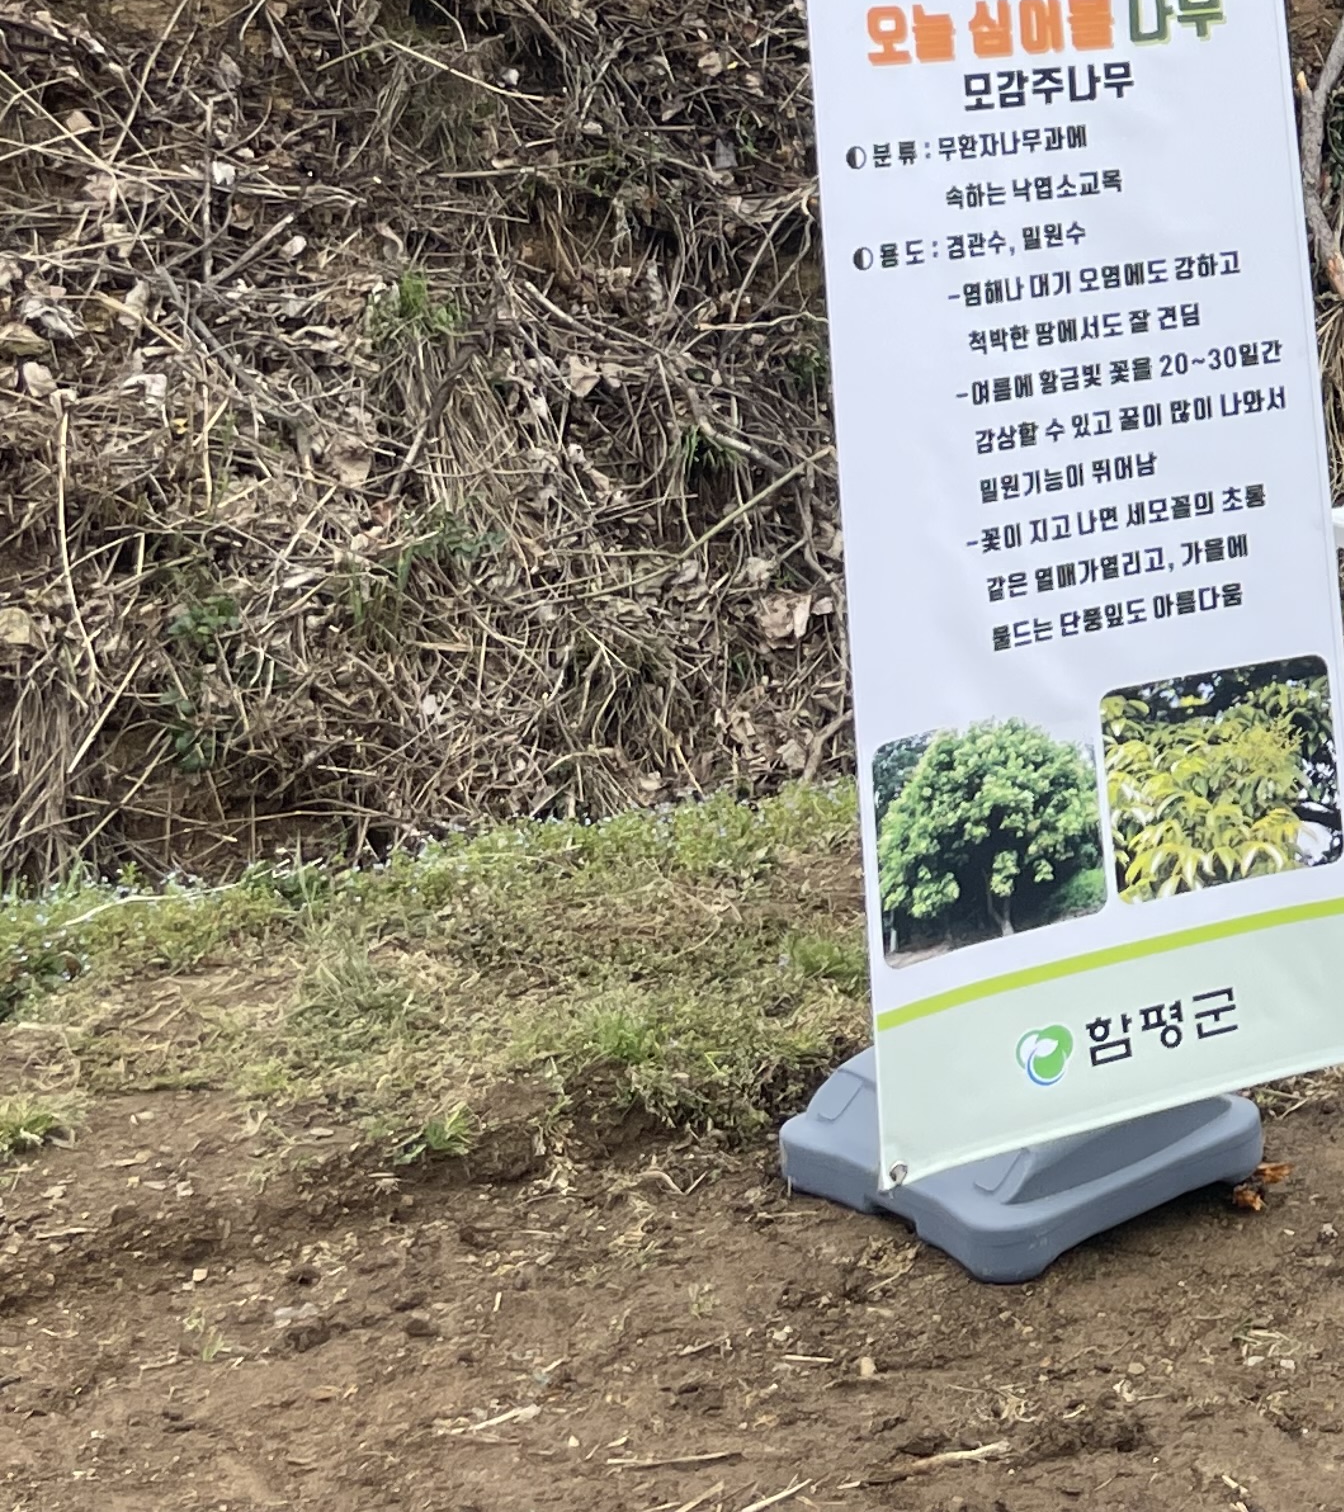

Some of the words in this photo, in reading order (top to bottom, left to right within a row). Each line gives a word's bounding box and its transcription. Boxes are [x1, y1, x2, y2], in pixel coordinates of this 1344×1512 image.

[867, 5, 954, 65] 오늘
[964, 62, 1134, 111] 모감주나무
[939, 125, 1086, 161] 무환자나무과에
[946, 183, 1005, 209] 속하는
[1013, 170, 1122, 202] 낙엽소교목
[947, 231, 1014, 260] 경관수,
[1023, 222, 1085, 250] 밀원수
[1030, 271, 1071, 298] 대기
[1080, 260, 1168, 292] 오염에도
[1175, 251, 1240, 280] 강하고
[969, 325, 1029, 354] 척박한
[1036, 313, 1123, 346] 땅에서도
[1129, 310, 1150, 333] 잘
[1158, 303, 1199, 330] 견딤
[1039, 364, 1101, 394] 황금빛
[1110, 357, 1152, 384] 꽃을
[1160, 340, 1282, 377] 20~30일간
[976, 422, 1038, 454] 감상할
[1046, 419, 1064, 442] 수
[1072, 411, 1112, 438] 있고
[1120, 403, 1161, 431] 꿀이
[1170, 396, 1212, 424] 많이
[1221, 387, 1285, 416] 나와서
[981, 463, 1084, 503] 밀원기능이
[1092, 453, 1157, 483] 뛰어남
[1030, 515, 1071, 544] 지고
[1077, 507, 1118, 535] 나면
[1127, 492, 1214, 527] 세모꼴의
[987, 572, 1027, 602] 같은
[1181, 534, 1248, 566] 가을에
[993, 619, 1053, 651] 물드는
[1060, 599, 1146, 637] 단풍잎도
[1153, 583, 1242, 619] 아름다움
[1086, 988, 1238, 1066] 함평군
